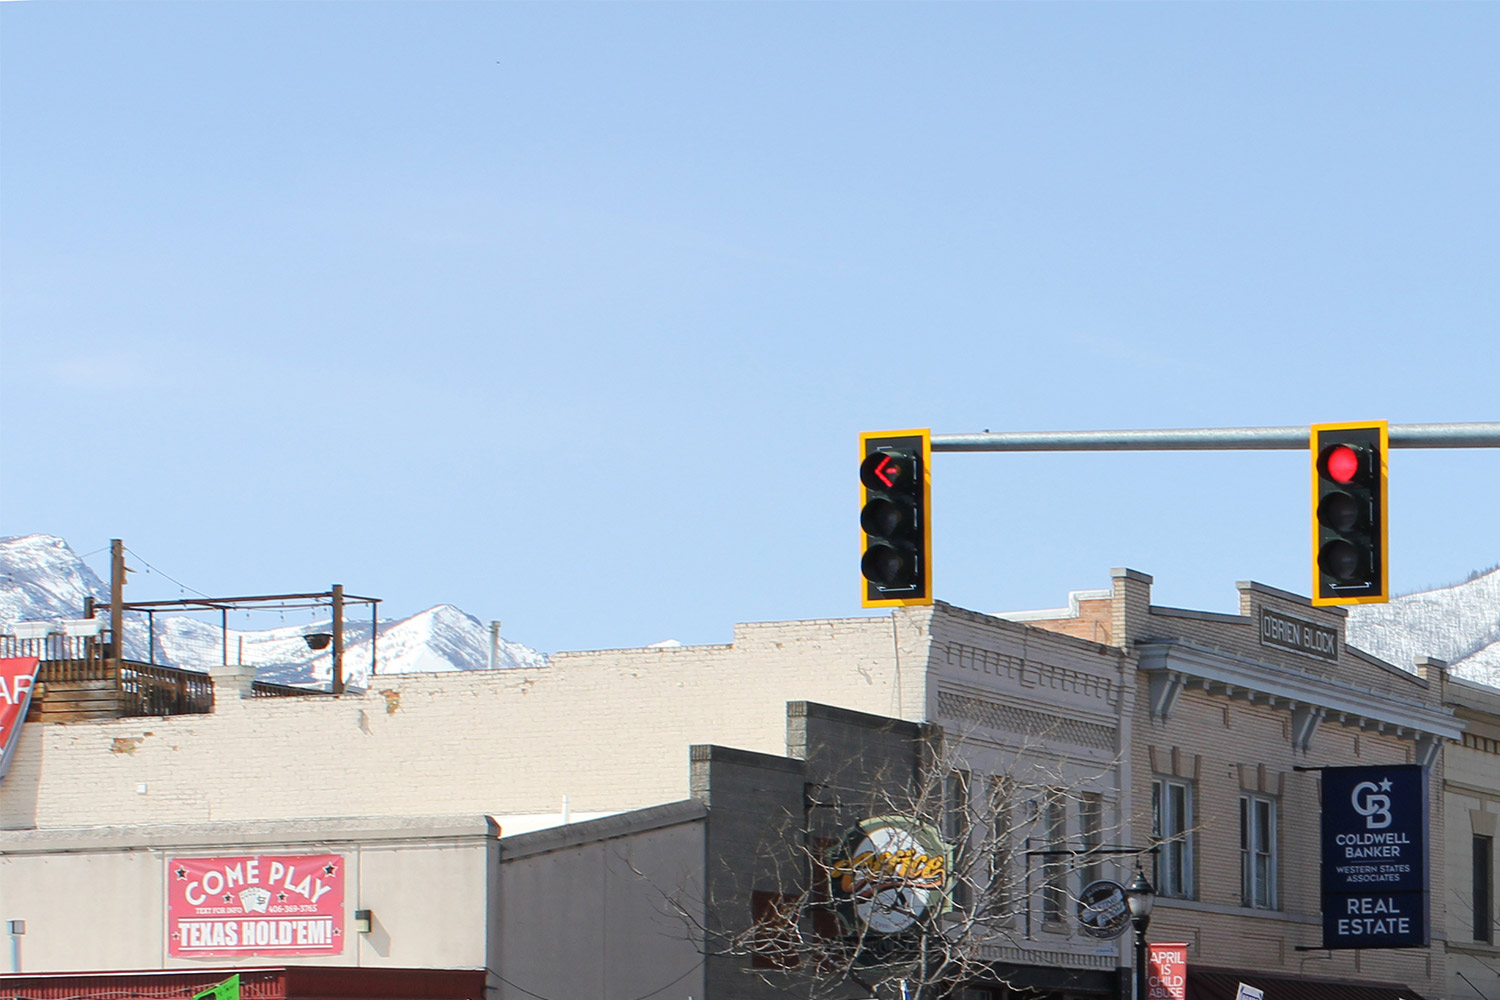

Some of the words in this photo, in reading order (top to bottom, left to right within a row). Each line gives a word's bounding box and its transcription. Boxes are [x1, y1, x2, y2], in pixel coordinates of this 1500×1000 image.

[1263, 615, 1300, 646] O'BRIEN
[1303, 626, 1335, 655] BLOCK
[1335, 832, 1410, 846] COLDWELL
[1345, 846, 1400, 858] BANKER
[1336, 865, 1378, 874] WESTERN
[1379, 864, 1411, 873] STATES
[185, 860, 260, 905] COME
[268, 861, 332, 903] PLAY
[1346, 873, 1401, 883] ASSOCIATES
[227, 906, 243, 914] INFO
[1347, 897, 1400, 914] REAL
[1338, 918, 1410, 935] ESTATE
[178, 922, 238, 946] TEXAS
[241, 920, 333, 945] HOLD'EM!
[1150, 952, 1185, 964] APRIL
[1160, 963, 1171, 975] IS
[1148, 975, 1183, 987] CHILD
[1149, 987, 1183, 998] ABUSE
